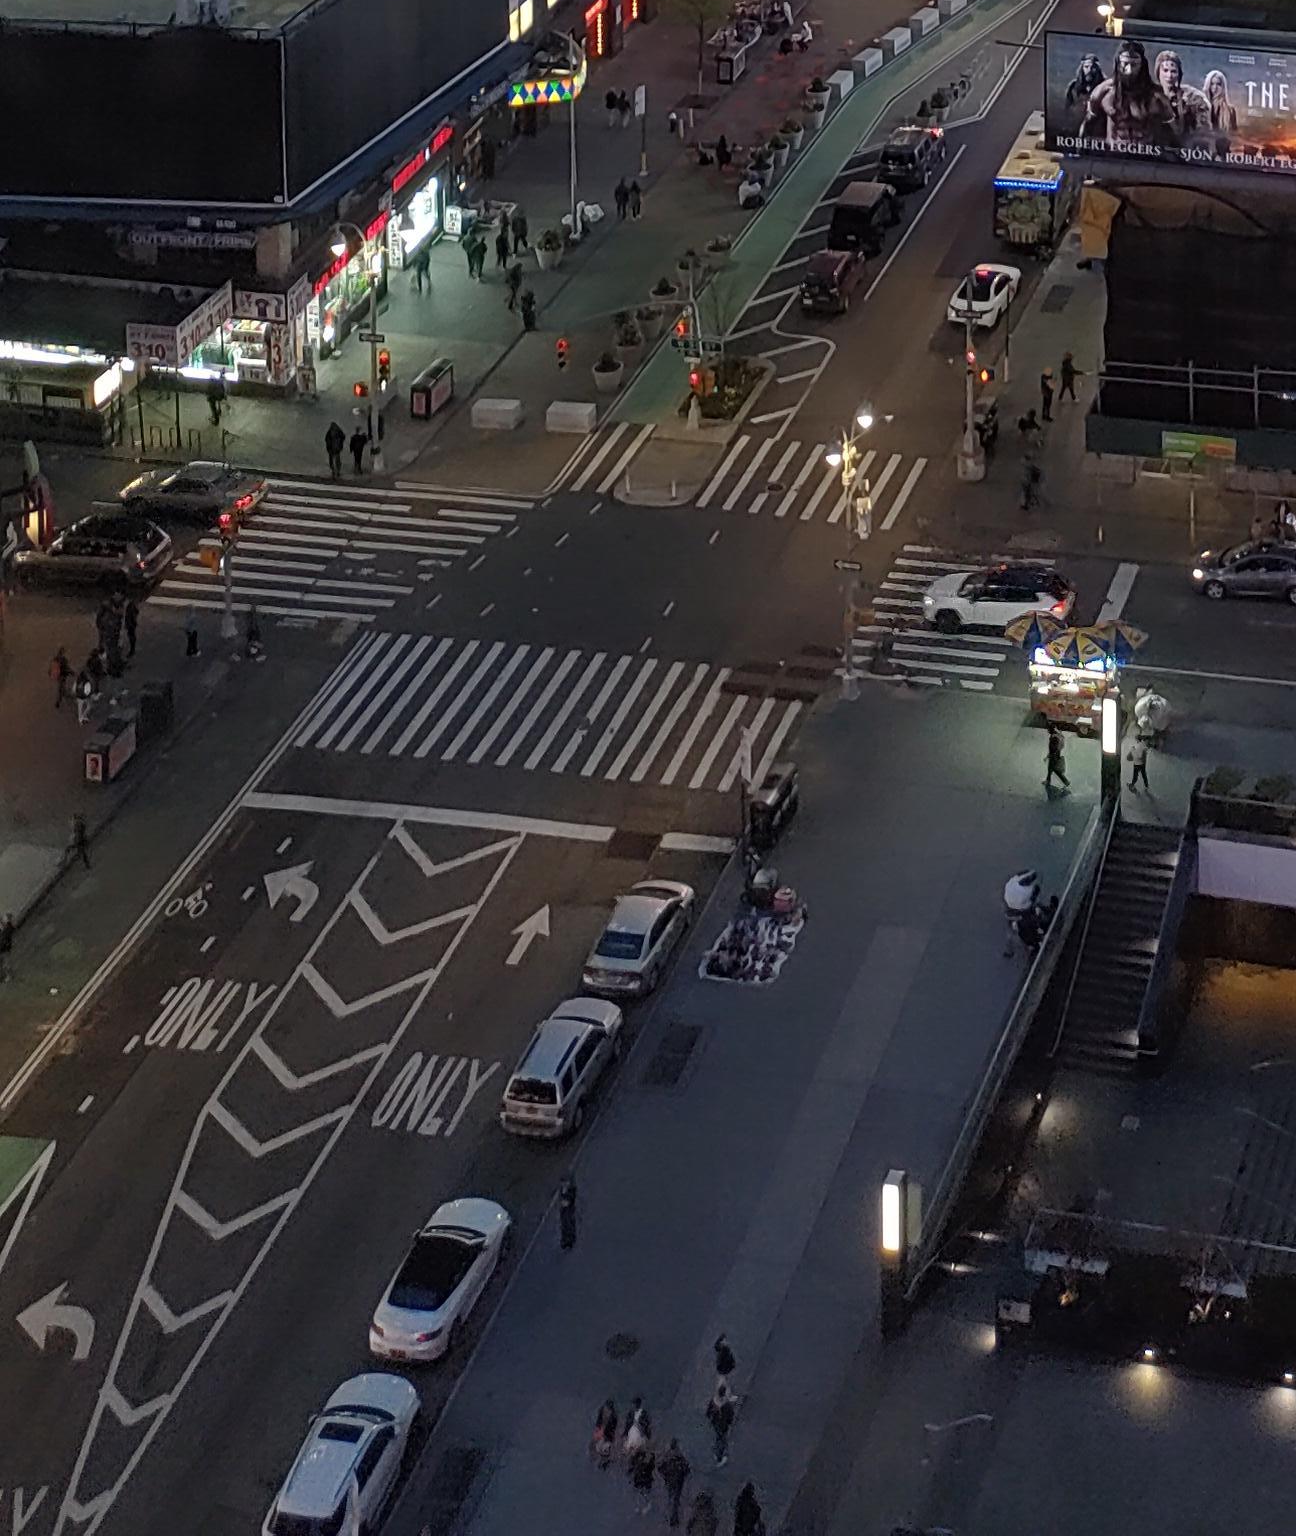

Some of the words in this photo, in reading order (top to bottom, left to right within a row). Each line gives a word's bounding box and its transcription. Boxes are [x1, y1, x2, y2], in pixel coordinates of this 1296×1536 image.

[1244, 80, 1290, 111] THE
[1056, 136, 1106, 152] ROBERT
[1110, 138, 1162, 156] EGGERS
[1180, 147, 1213, 162] SJÓN
[1225, 152, 1276, 168] ROBERT
[144, 976, 277, 1052] ONLY
[370, 1051, 501, 1136] ONLY
